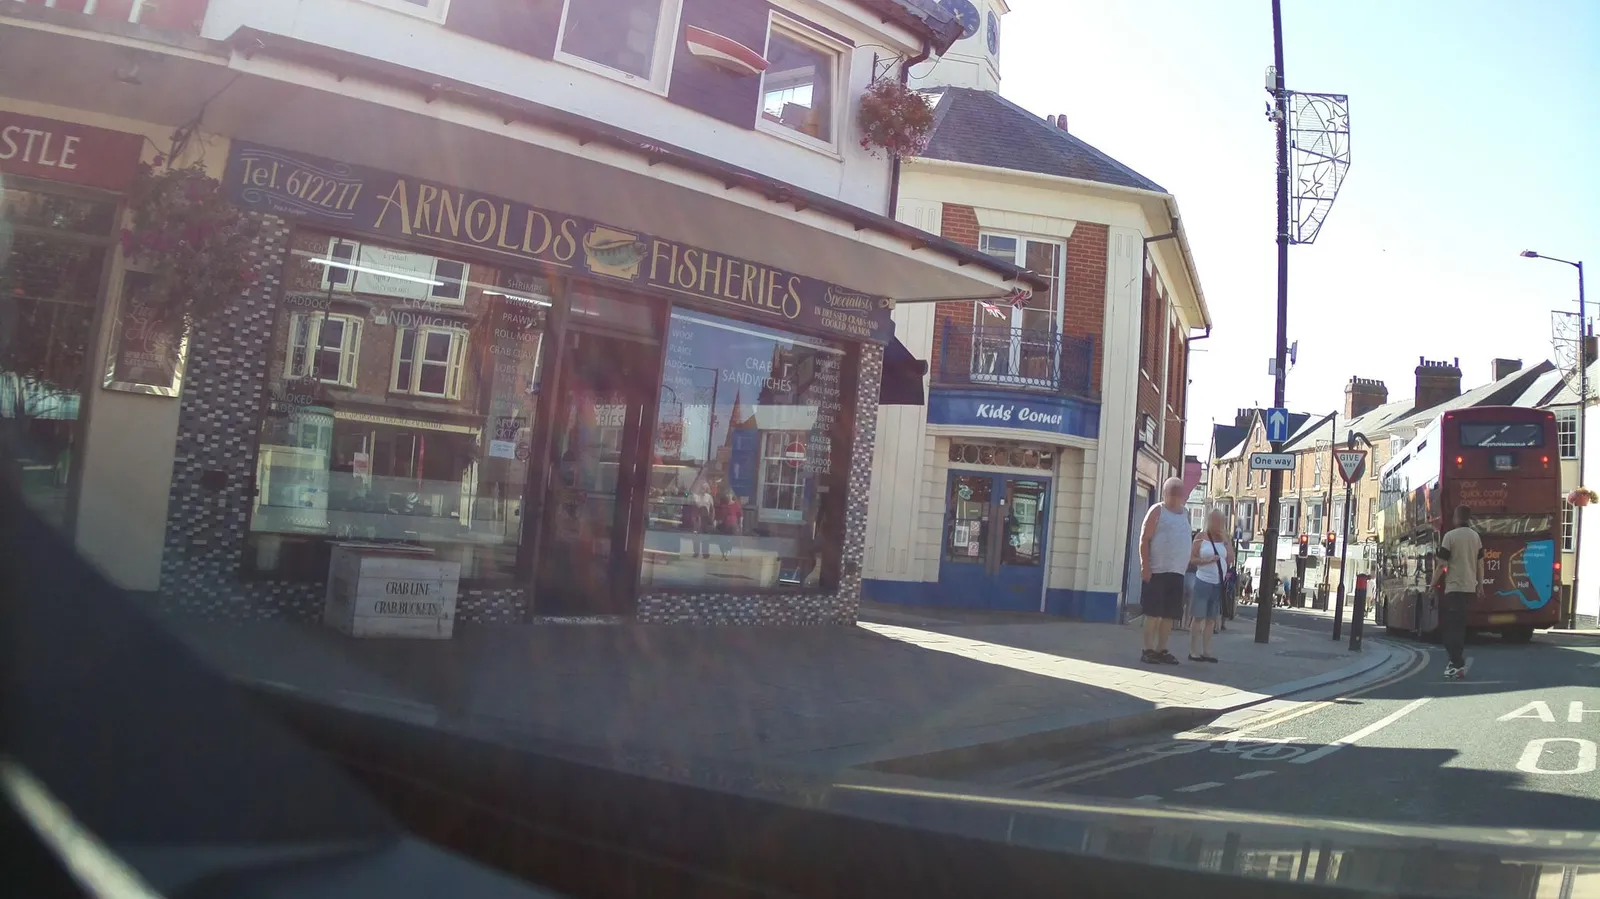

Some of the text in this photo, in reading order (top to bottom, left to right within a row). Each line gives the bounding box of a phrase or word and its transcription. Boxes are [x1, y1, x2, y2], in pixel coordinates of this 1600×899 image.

[0, 125, 81, 170] STLE
[286, 169, 363, 210] 672277
[373, 179, 801, 319] ARNOLDS FISHERIES
[824, 286, 873, 311] Specialists
[745, 357, 773, 373] CRAB
[722, 369, 793, 392] SANDWICHES
[976, 403, 1063, 425] Kids' Corner
[1254, 456, 1292, 469] One way
[1339, 454, 1360, 463] GIVE
[1343, 461, 1357, 469] WAY
[1486, 560, 1501, 571] 121
[385, 581, 410, 596] CRAB
[374, 600, 438, 616] CRAB BUCKETS
